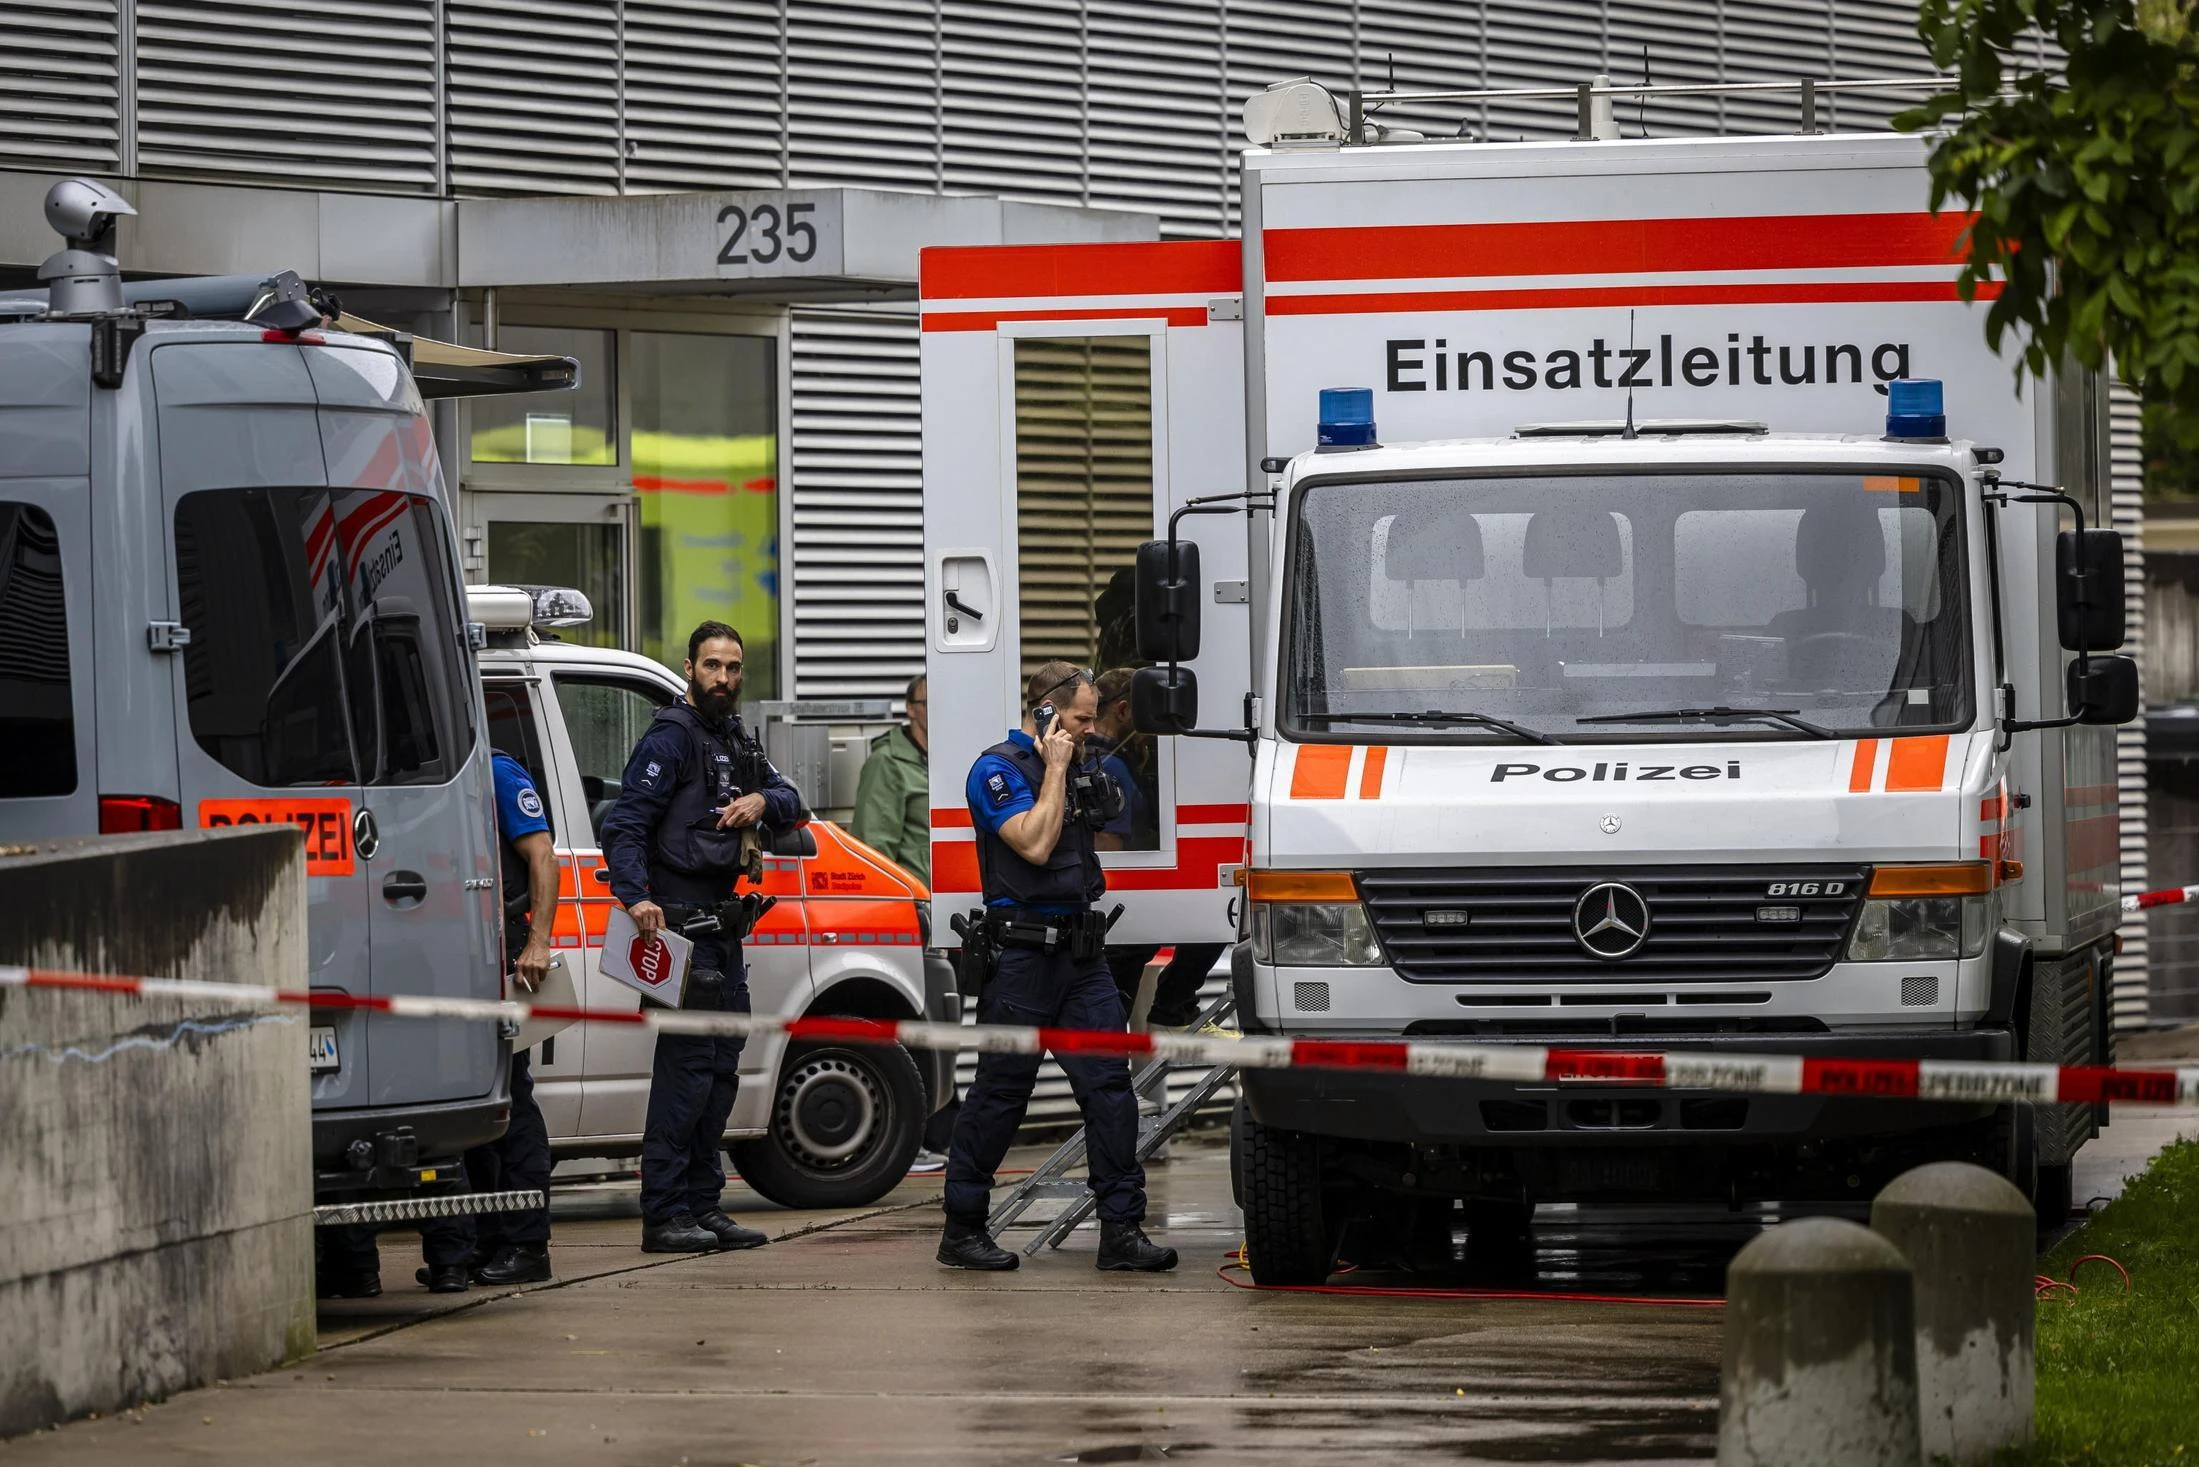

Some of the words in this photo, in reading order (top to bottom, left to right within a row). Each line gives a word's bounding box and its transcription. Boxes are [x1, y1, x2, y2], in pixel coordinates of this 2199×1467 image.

[716, 203, 817, 265] 235
[1386, 333, 1910, 398] Einsatzleitung
[1490, 760, 1741, 783] Polizei
[1767, 883, 1820, 896] 816
[1824, 882, 1845, 895] D
